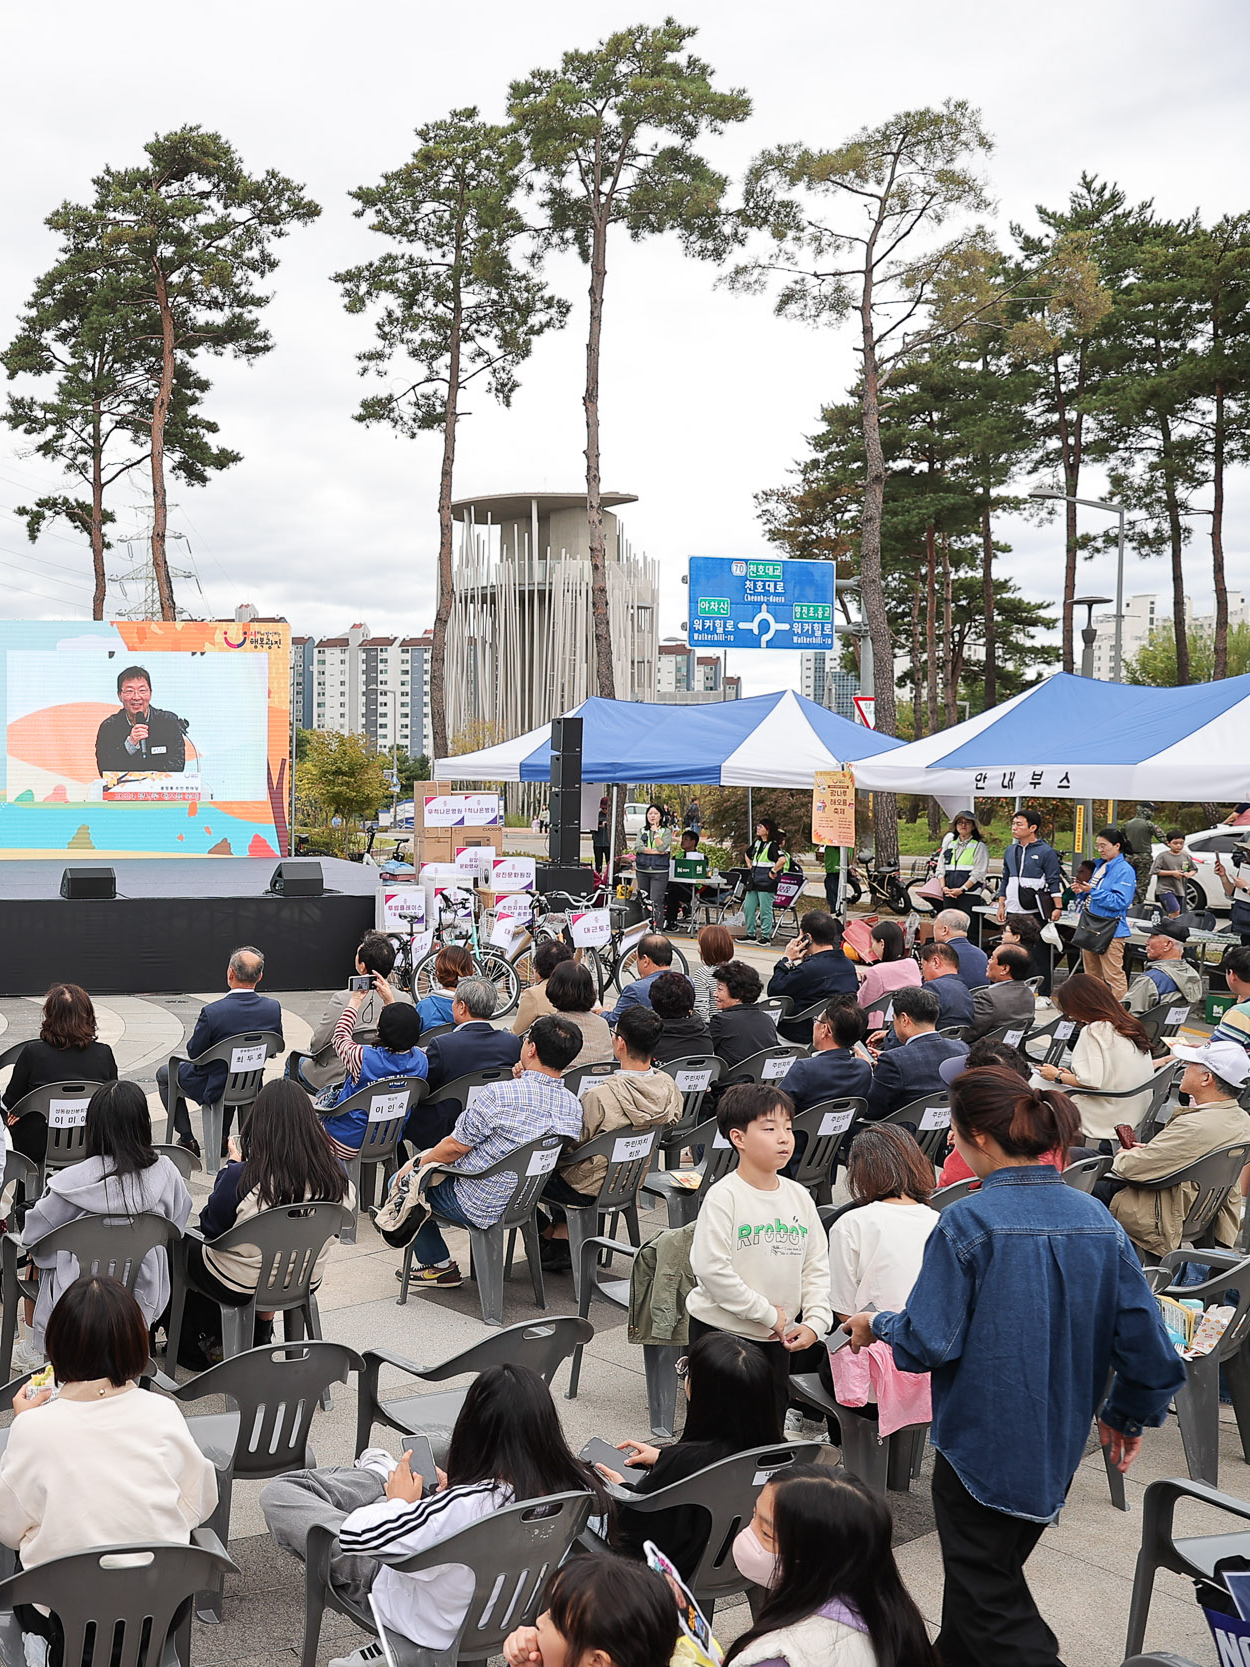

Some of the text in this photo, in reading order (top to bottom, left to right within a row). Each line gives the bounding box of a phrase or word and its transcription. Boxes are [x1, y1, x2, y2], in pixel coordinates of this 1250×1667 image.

[734, 563, 744, 574] 70
[748, 564, 781, 577] 천호대교
[745, 580, 785, 593] 천호대로
[745, 594, 785, 603] Cheonho-daero
[700, 601, 728, 614] 아차산
[693, 619, 735, 632] 워커힐로
[792, 623, 832, 637] 워커힐로
[693, 633, 735, 642] Walkerhill-ro
[793, 636, 832, 645] Walkerhill-ro
[684, 1074, 706, 1082] 주민자치
[623, 1138, 649, 1149] 주민자치
[628, 1150, 641, 1158] 회장
